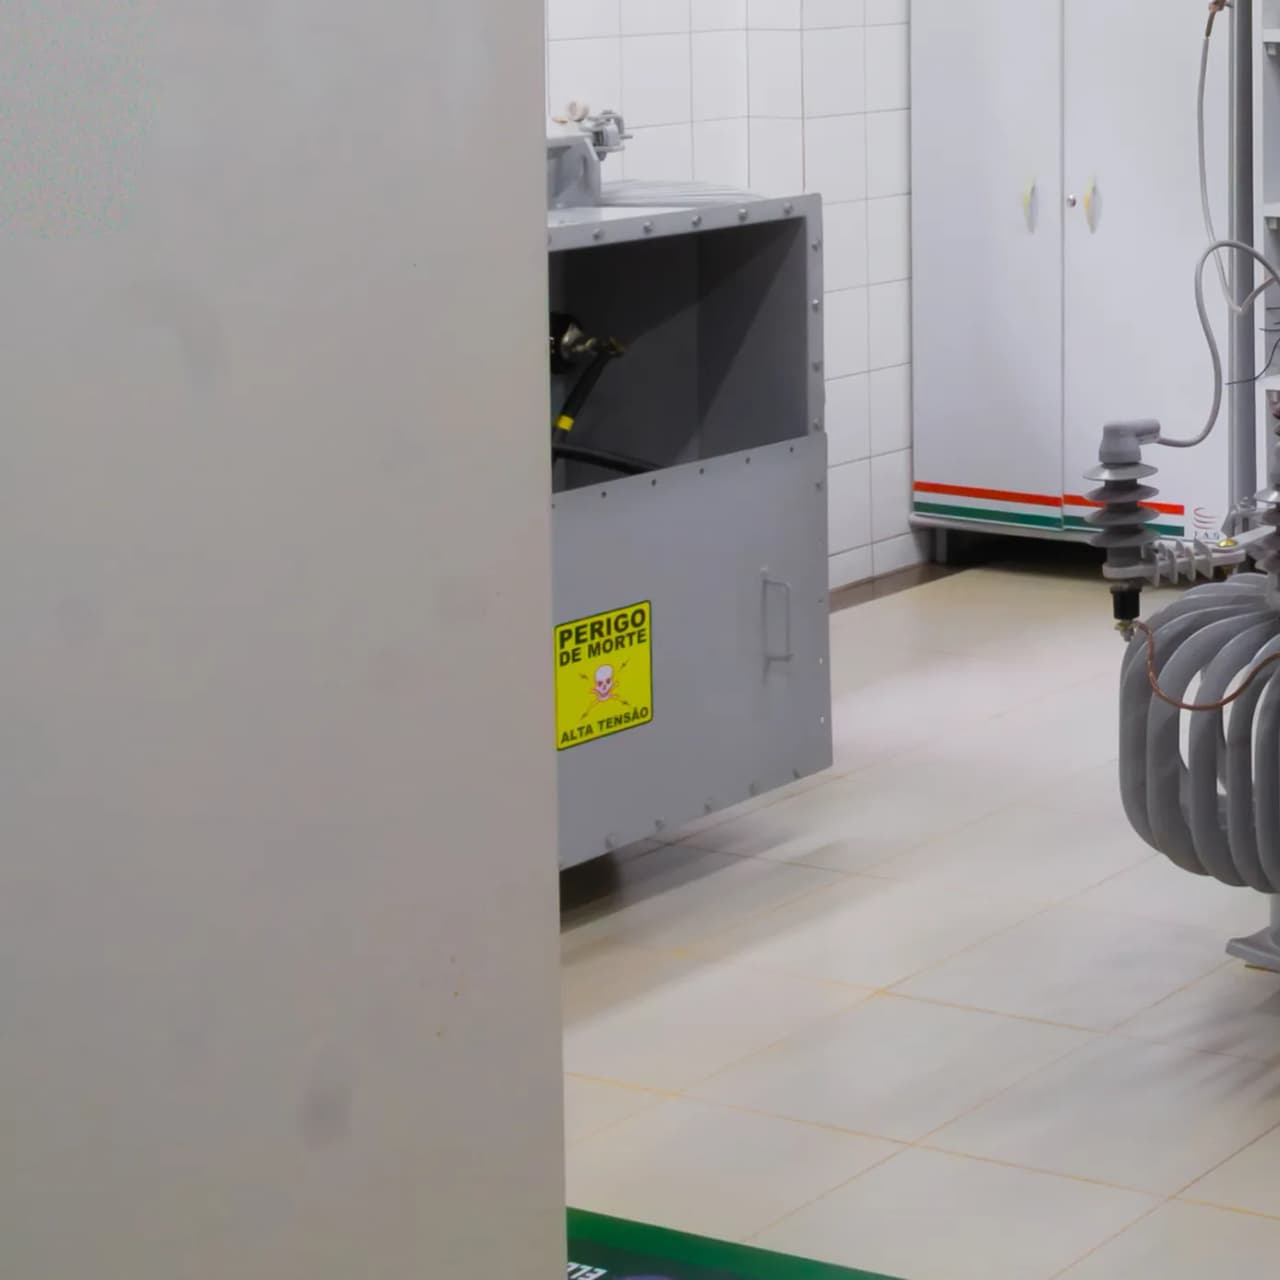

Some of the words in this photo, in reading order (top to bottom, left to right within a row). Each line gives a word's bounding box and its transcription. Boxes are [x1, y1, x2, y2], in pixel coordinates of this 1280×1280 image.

[559, 607, 647, 650] PERIGO
[559, 647, 582, 667] DE
[587, 628, 647, 660] MORTE
[560, 723, 594, 744] ALTA
[597, 706, 649, 732] TENSÃO
